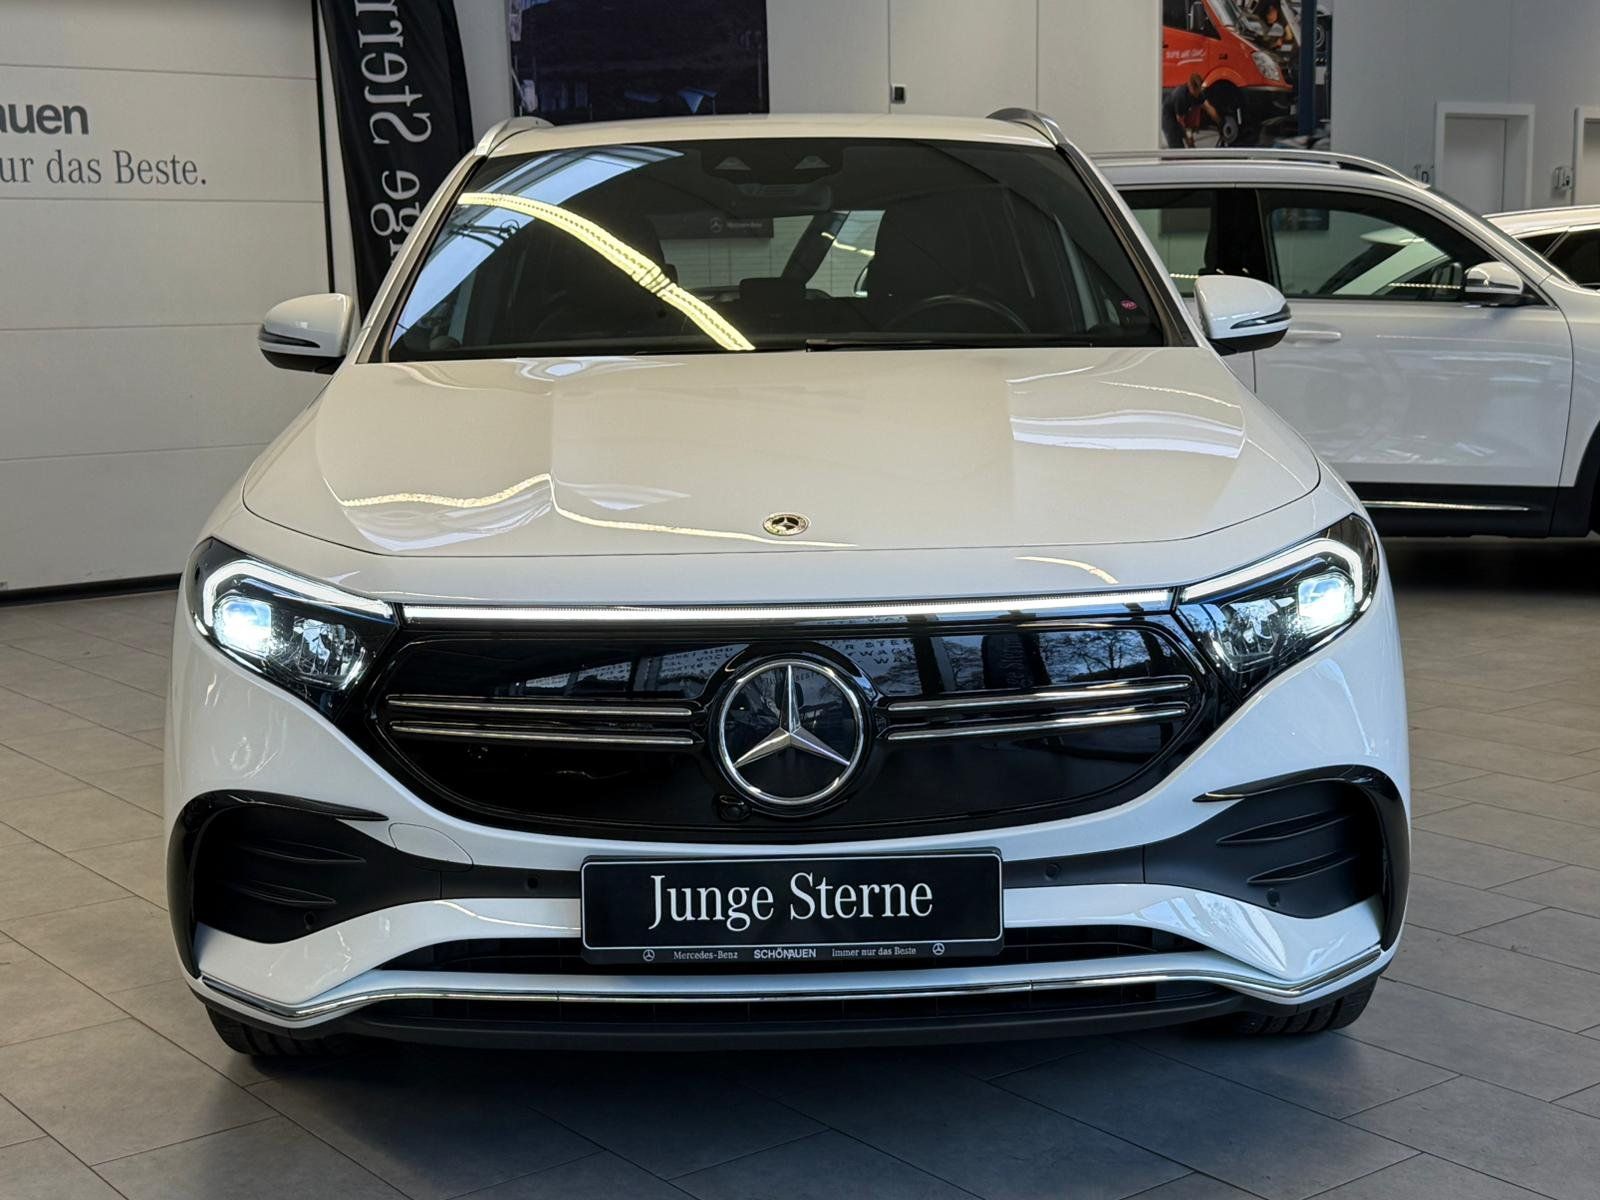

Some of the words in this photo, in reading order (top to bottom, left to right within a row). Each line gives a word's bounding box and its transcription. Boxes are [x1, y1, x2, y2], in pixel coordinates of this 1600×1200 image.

[0, 103, 89, 135] uen
[46, 149, 102, 184] das
[113, 149, 207, 185] Beste.
[648, 874, 775, 932] Junge
[789, 872, 933, 920] Sterne
[673, 950, 739, 960] Mercedes-Benz
[753, 947, 817, 960] SCHÖNAUEN
[831, 948, 859, 957] Immer
[861, 948, 876, 957] nur
[877, 946, 893, 956] das
[894, 945, 917, 956] Beste
